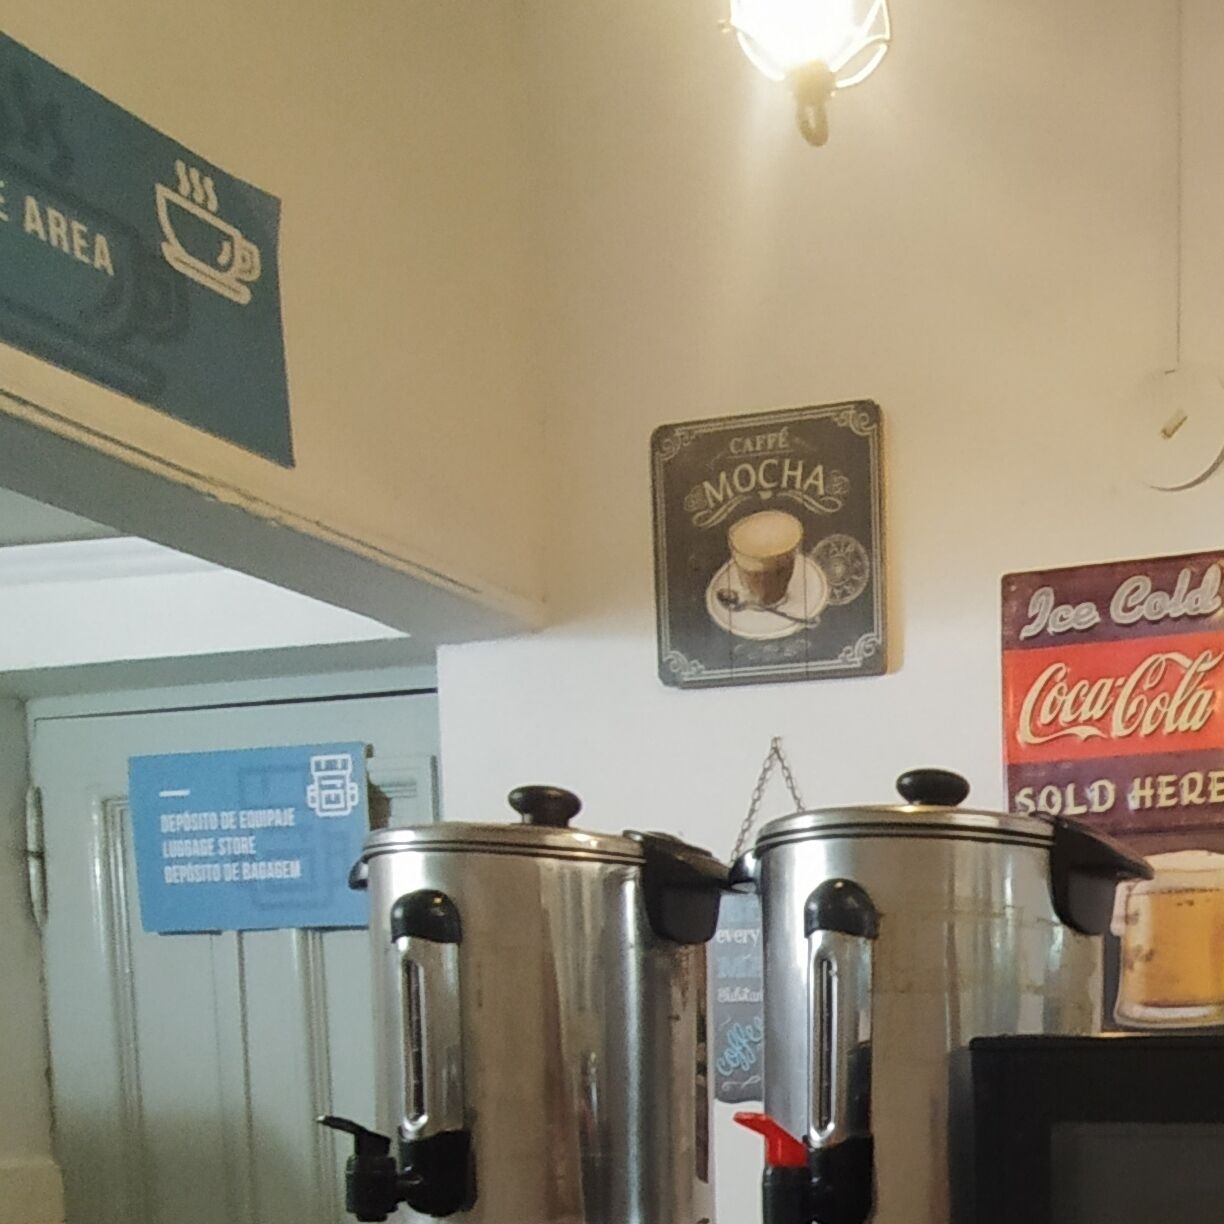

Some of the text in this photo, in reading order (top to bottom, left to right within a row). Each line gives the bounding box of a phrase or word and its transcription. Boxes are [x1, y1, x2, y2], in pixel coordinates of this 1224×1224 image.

[24, 195, 114, 276] AREA
[729, 427, 790, 455] CAFFÉ
[702, 459, 825, 507] MOCHA
[1020, 563, 1224, 640] Ice Cold
[1016, 649, 1224, 744] Coca-Cola
[1015, 779, 1116, 816] SOLD
[220, 811, 236, 829] DE
[239, 808, 295, 828] EQUIPAJE
[162, 836, 256, 858] LUGGAGE STORE
[223, 863, 240, 881] DE
[716, 928, 760, 946] every
